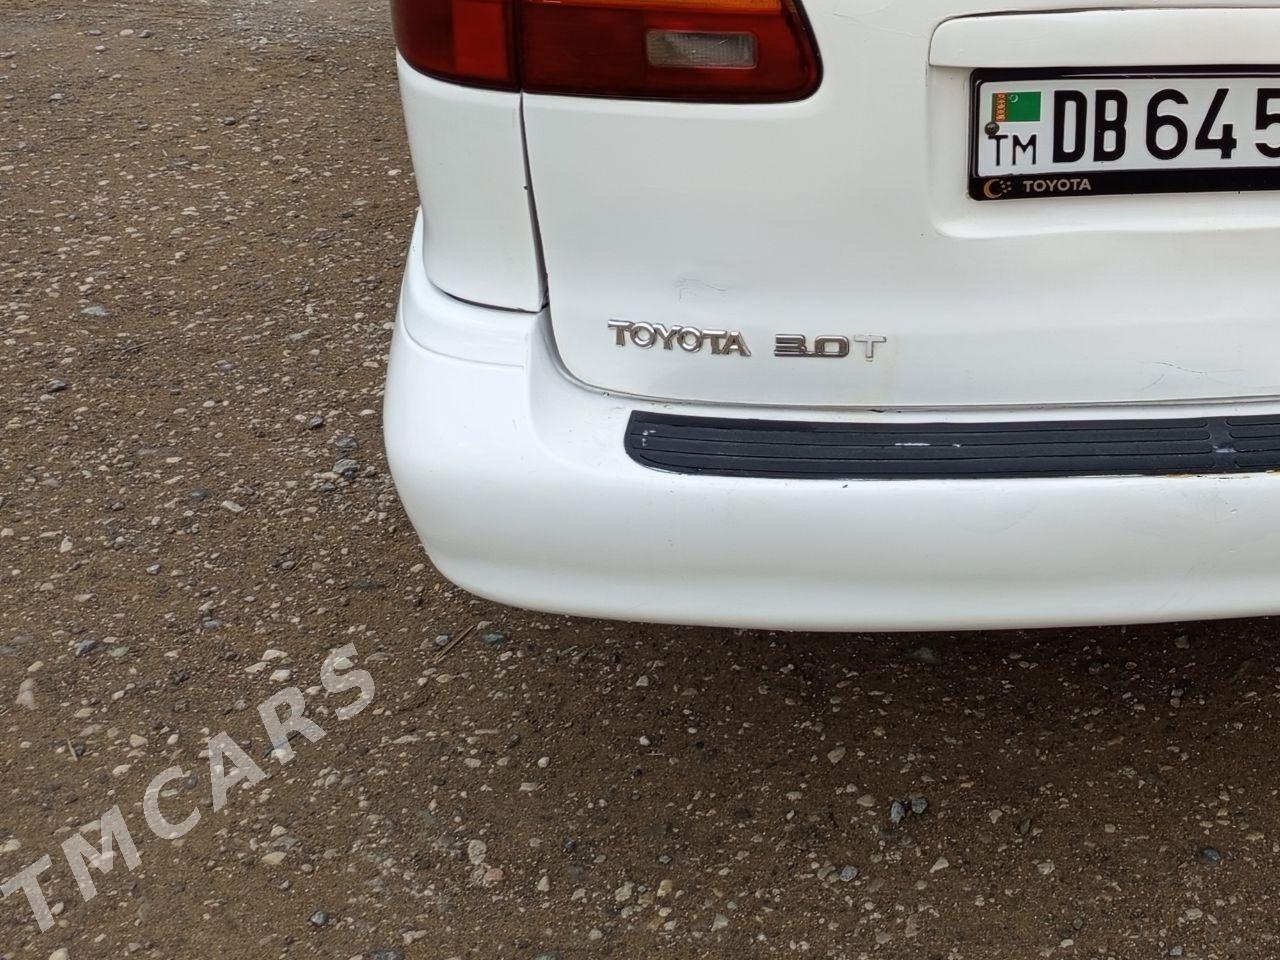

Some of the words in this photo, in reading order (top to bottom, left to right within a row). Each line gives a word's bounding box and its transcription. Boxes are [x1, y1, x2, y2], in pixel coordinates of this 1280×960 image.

[988, 133, 1037, 167] TM
[1022, 178, 1092, 194] TOYOTA
[606, 318, 752, 358] TOYOTA
